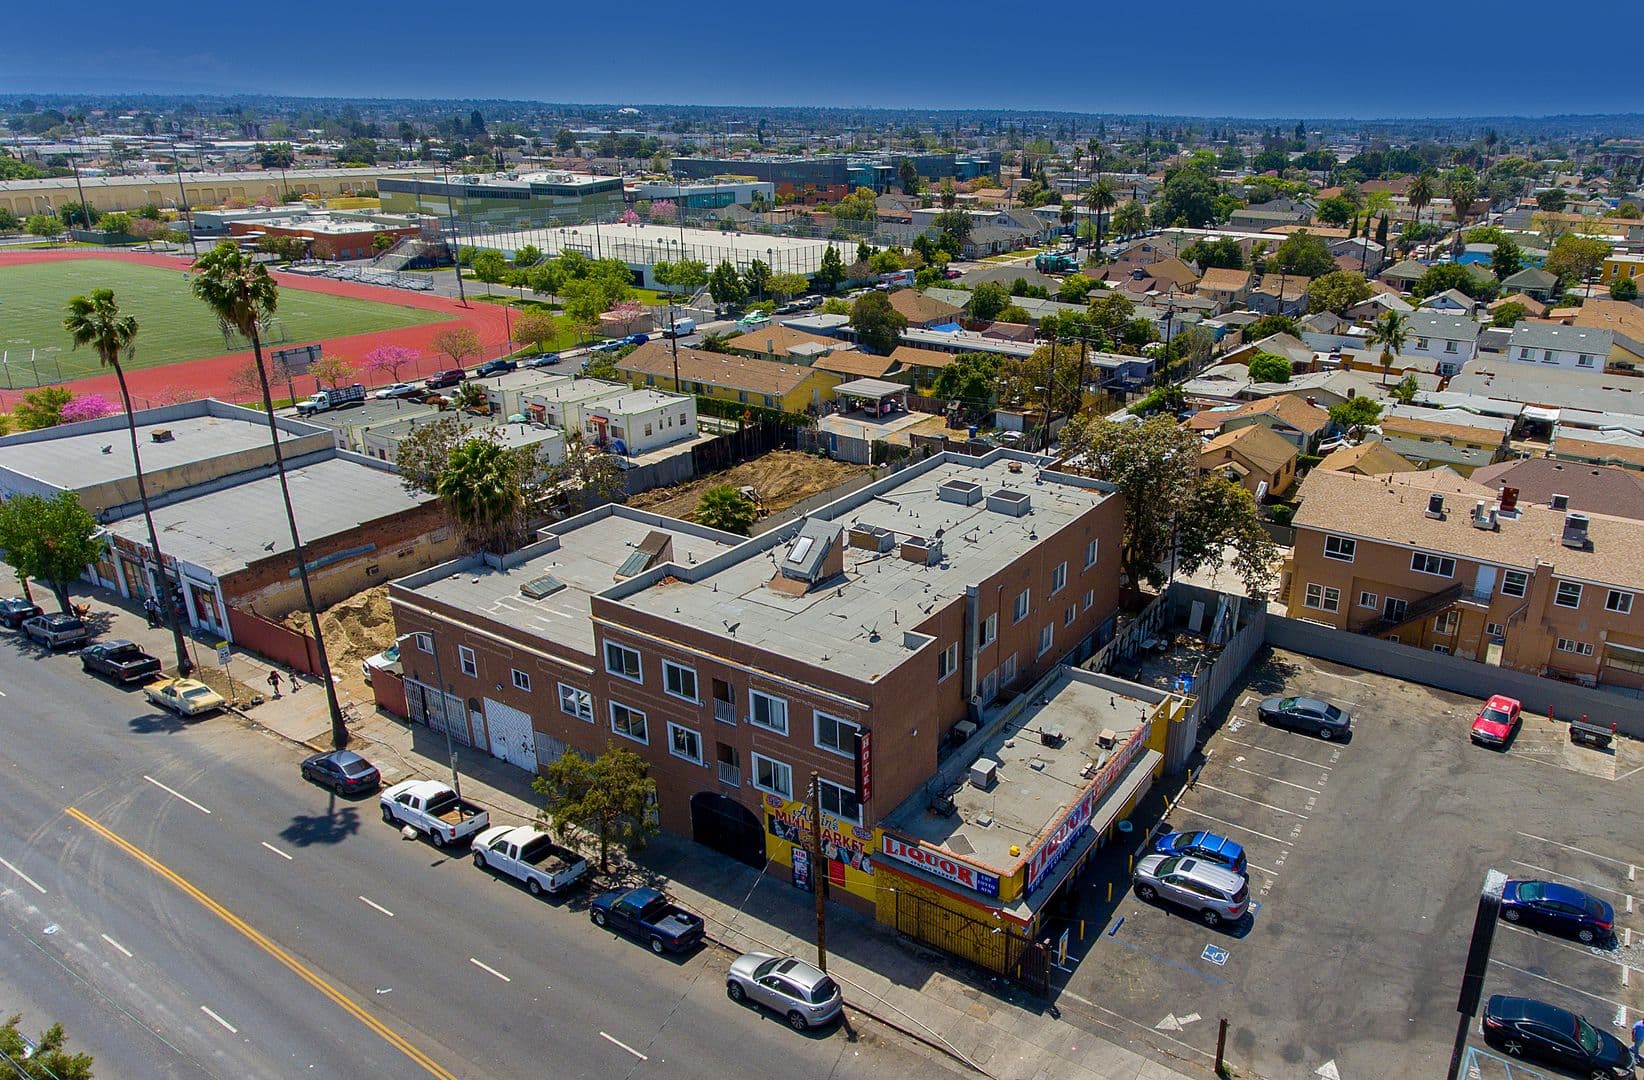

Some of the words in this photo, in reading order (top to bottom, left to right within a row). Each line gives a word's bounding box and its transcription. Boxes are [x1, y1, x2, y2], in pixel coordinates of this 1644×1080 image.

[862, 737, 870, 798] HOTEL
[793, 805, 839, 831] Alin's
[1030, 798, 1091, 882] LIQUOR
[885, 838, 974, 887] LIQUOR
